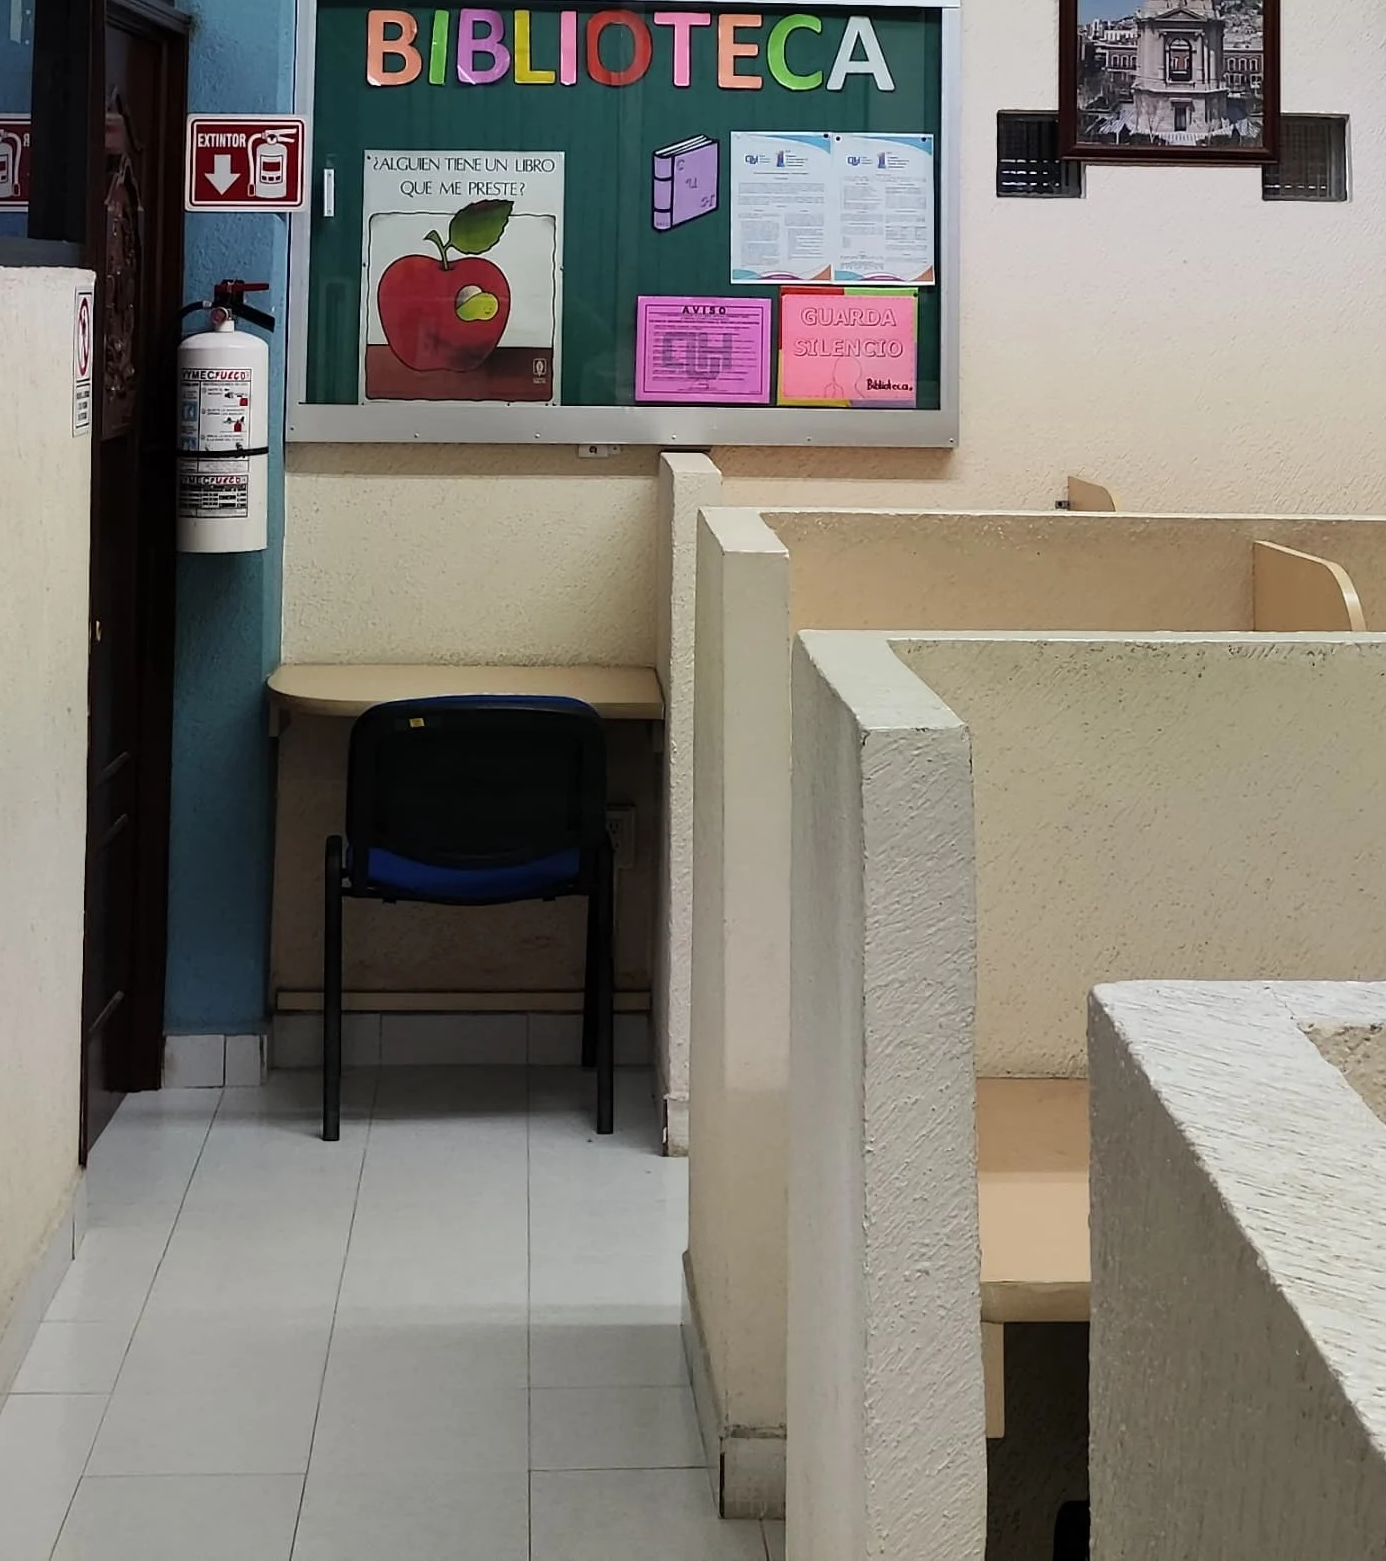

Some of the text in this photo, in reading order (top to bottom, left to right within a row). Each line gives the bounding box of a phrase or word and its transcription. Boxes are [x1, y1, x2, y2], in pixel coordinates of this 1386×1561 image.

[365, 8, 896, 92] BIBLIOTECA
[197, 132, 247, 148] EXTINTOR
[373, 156, 555, 172] ¿ALGUIEN TIENE UN LIBRO
[400, 180, 526, 197] QUE ME PRESTE?
[682, 306, 726, 315] AVISO
[800, 307, 897, 327] GUARDA
[793, 338, 904, 358] SILENCIO
